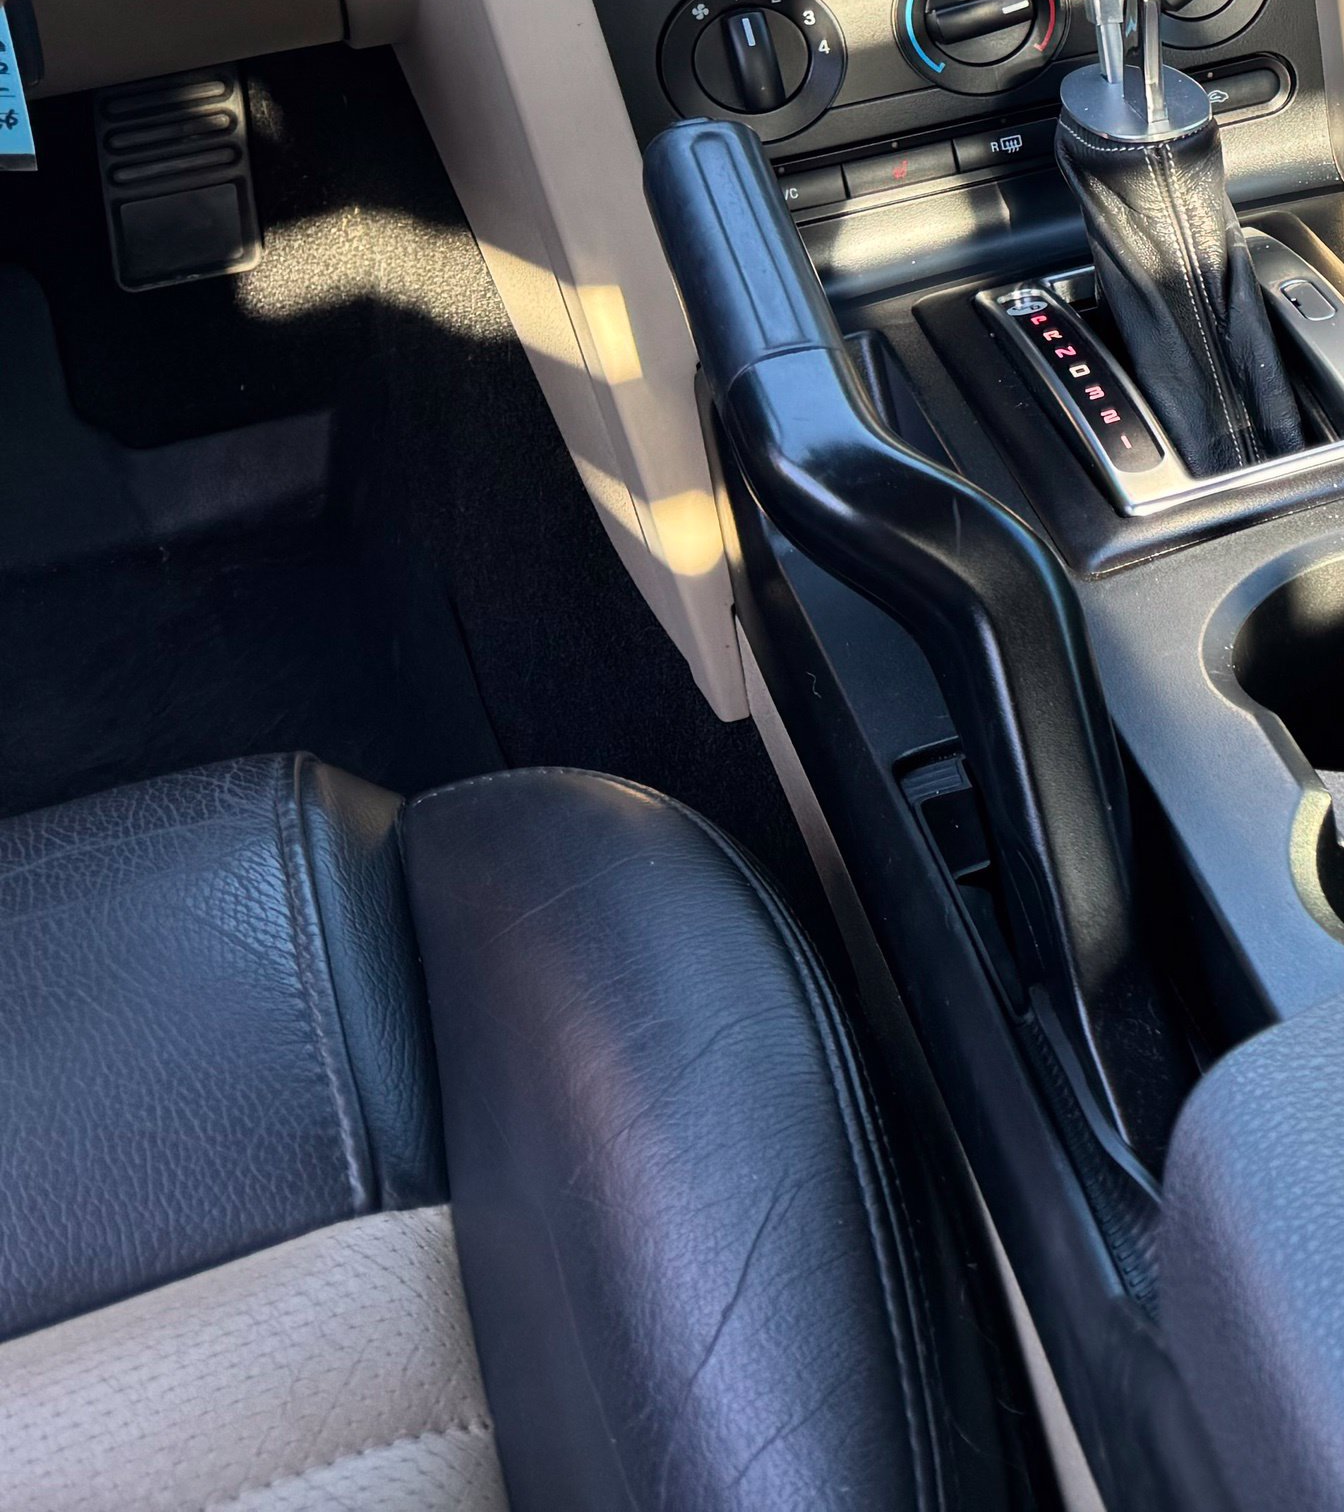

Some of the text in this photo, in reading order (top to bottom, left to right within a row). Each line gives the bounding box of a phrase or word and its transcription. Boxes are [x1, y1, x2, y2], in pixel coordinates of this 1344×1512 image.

[802, 10, 816, 26] 3
[818, 39, 831, 54] 4
[991, 142, 1000, 153] R
[1043, 329, 1064, 341] R
[1054, 345, 1077, 359] N
[1068, 364, 1091, 379] D
